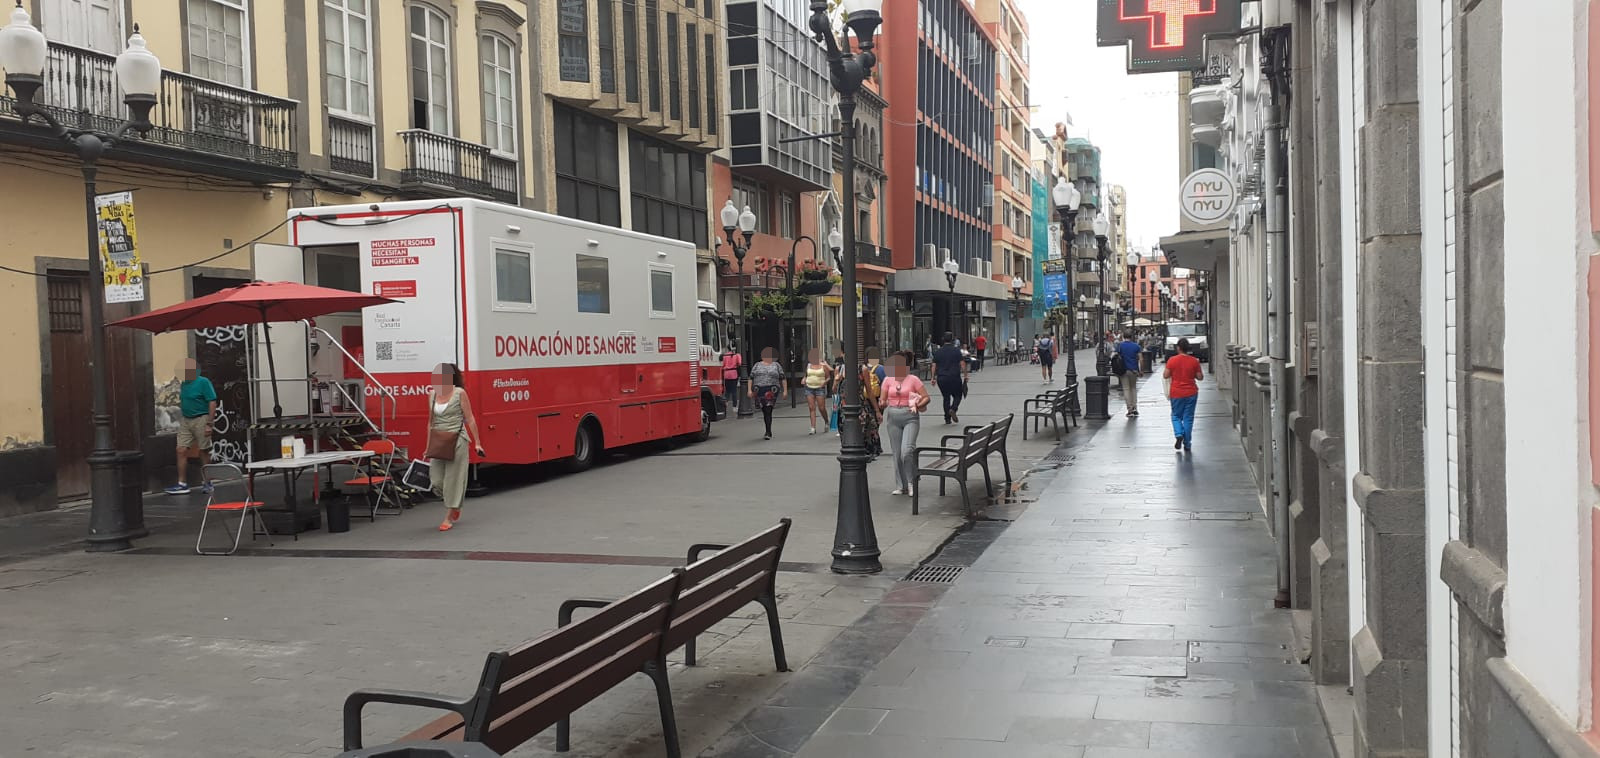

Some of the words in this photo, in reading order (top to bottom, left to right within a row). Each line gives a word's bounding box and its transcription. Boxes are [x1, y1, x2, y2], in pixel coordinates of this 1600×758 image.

[1193, 181, 1223, 192] NYU
[1193, 200, 1223, 211] NYU
[372, 240, 399, 248] MUCHAS
[400, 239, 434, 247] PERSONAS
[372, 249, 407, 257] NECESITAN
[373, 258, 381, 266] TU
[381, 257, 407, 265] SANGRE
[495, 330, 573, 357] DONACIÓN
[576, 335, 591, 356] DE
[593, 335, 637, 355] SANGRE
[384, 385, 400, 396] DE
